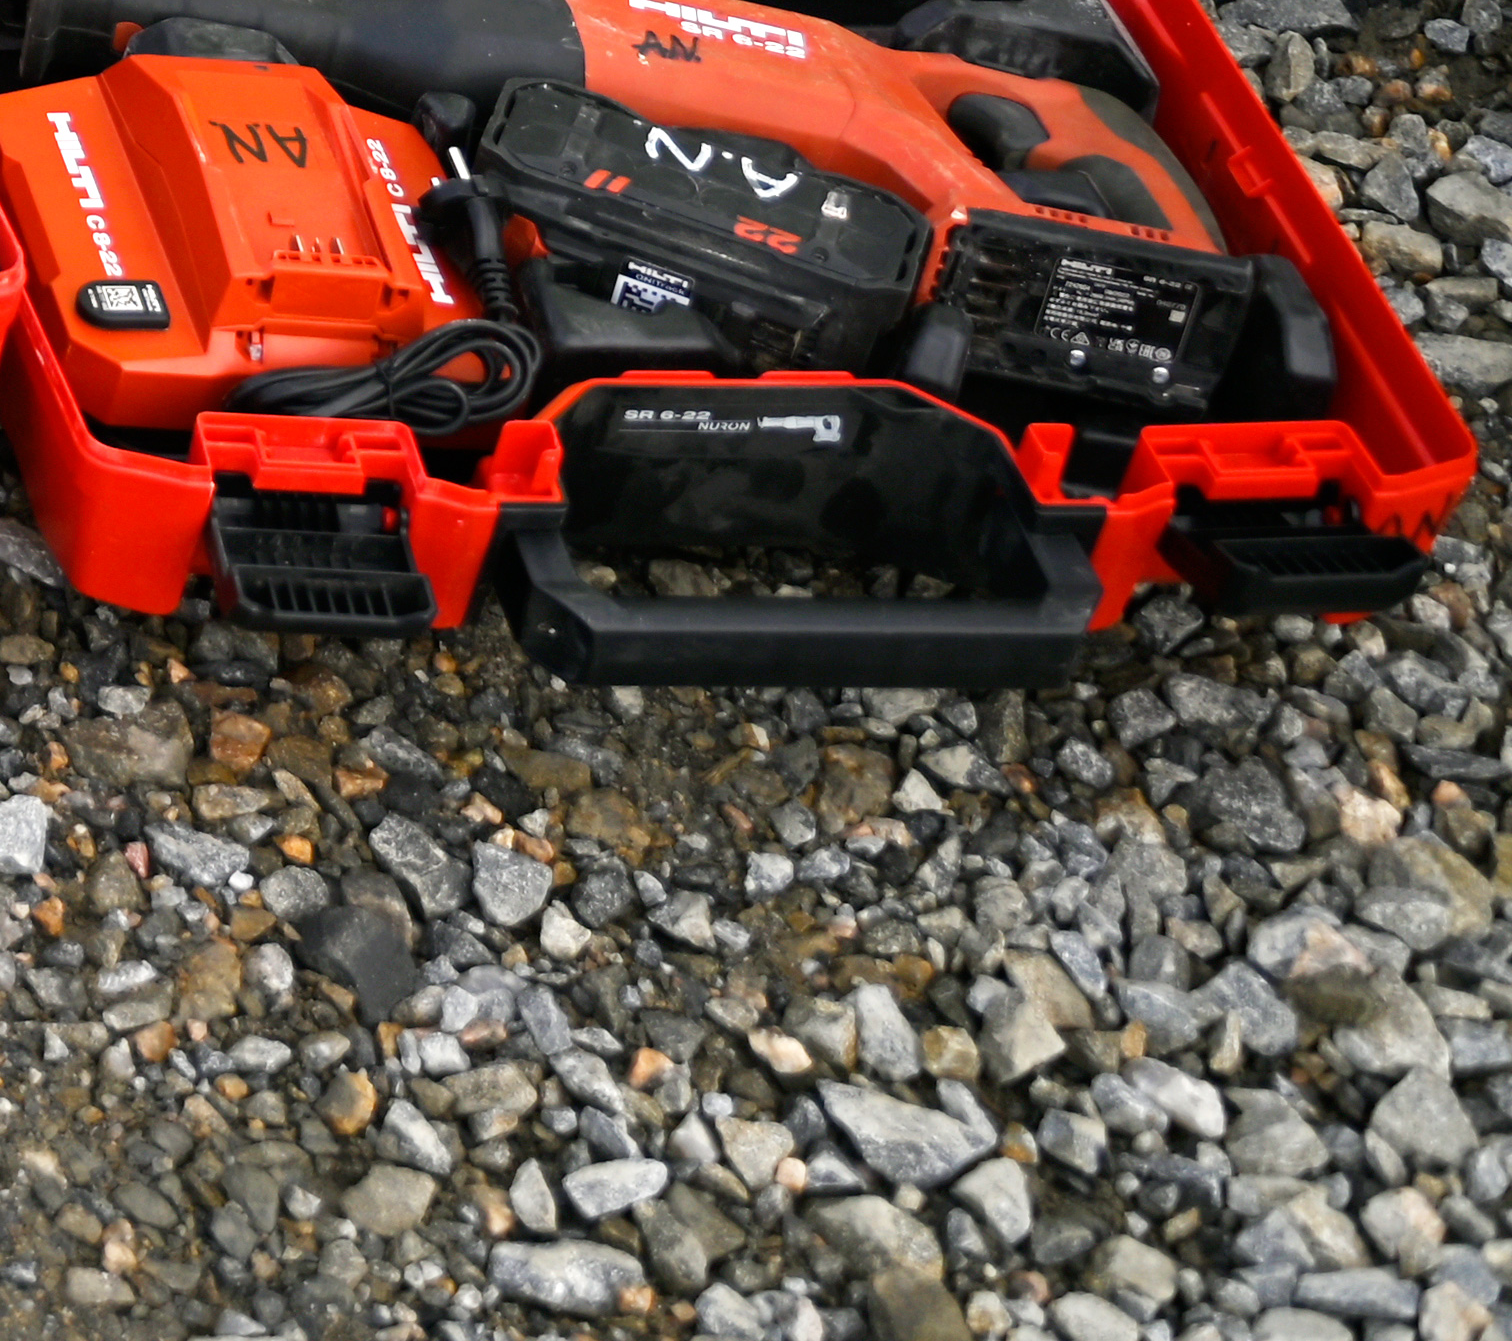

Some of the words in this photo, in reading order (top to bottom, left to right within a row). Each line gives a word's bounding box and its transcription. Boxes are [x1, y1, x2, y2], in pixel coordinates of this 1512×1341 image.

[680, 20, 724, 40] SR
[732, 33, 806, 59] 6-22
[47, 112, 105, 209] HILTI
[367, 138, 397, 182] 8-22
[387, 182, 405, 197] C
[86, 215, 107, 231] C
[93, 231, 124, 277] 8-22
[391, 203, 455, 305] HILTI
[628, 261, 690, 288] HILTI
[624, 410, 654, 421] SR
[659, 410, 712, 421] 6-22
